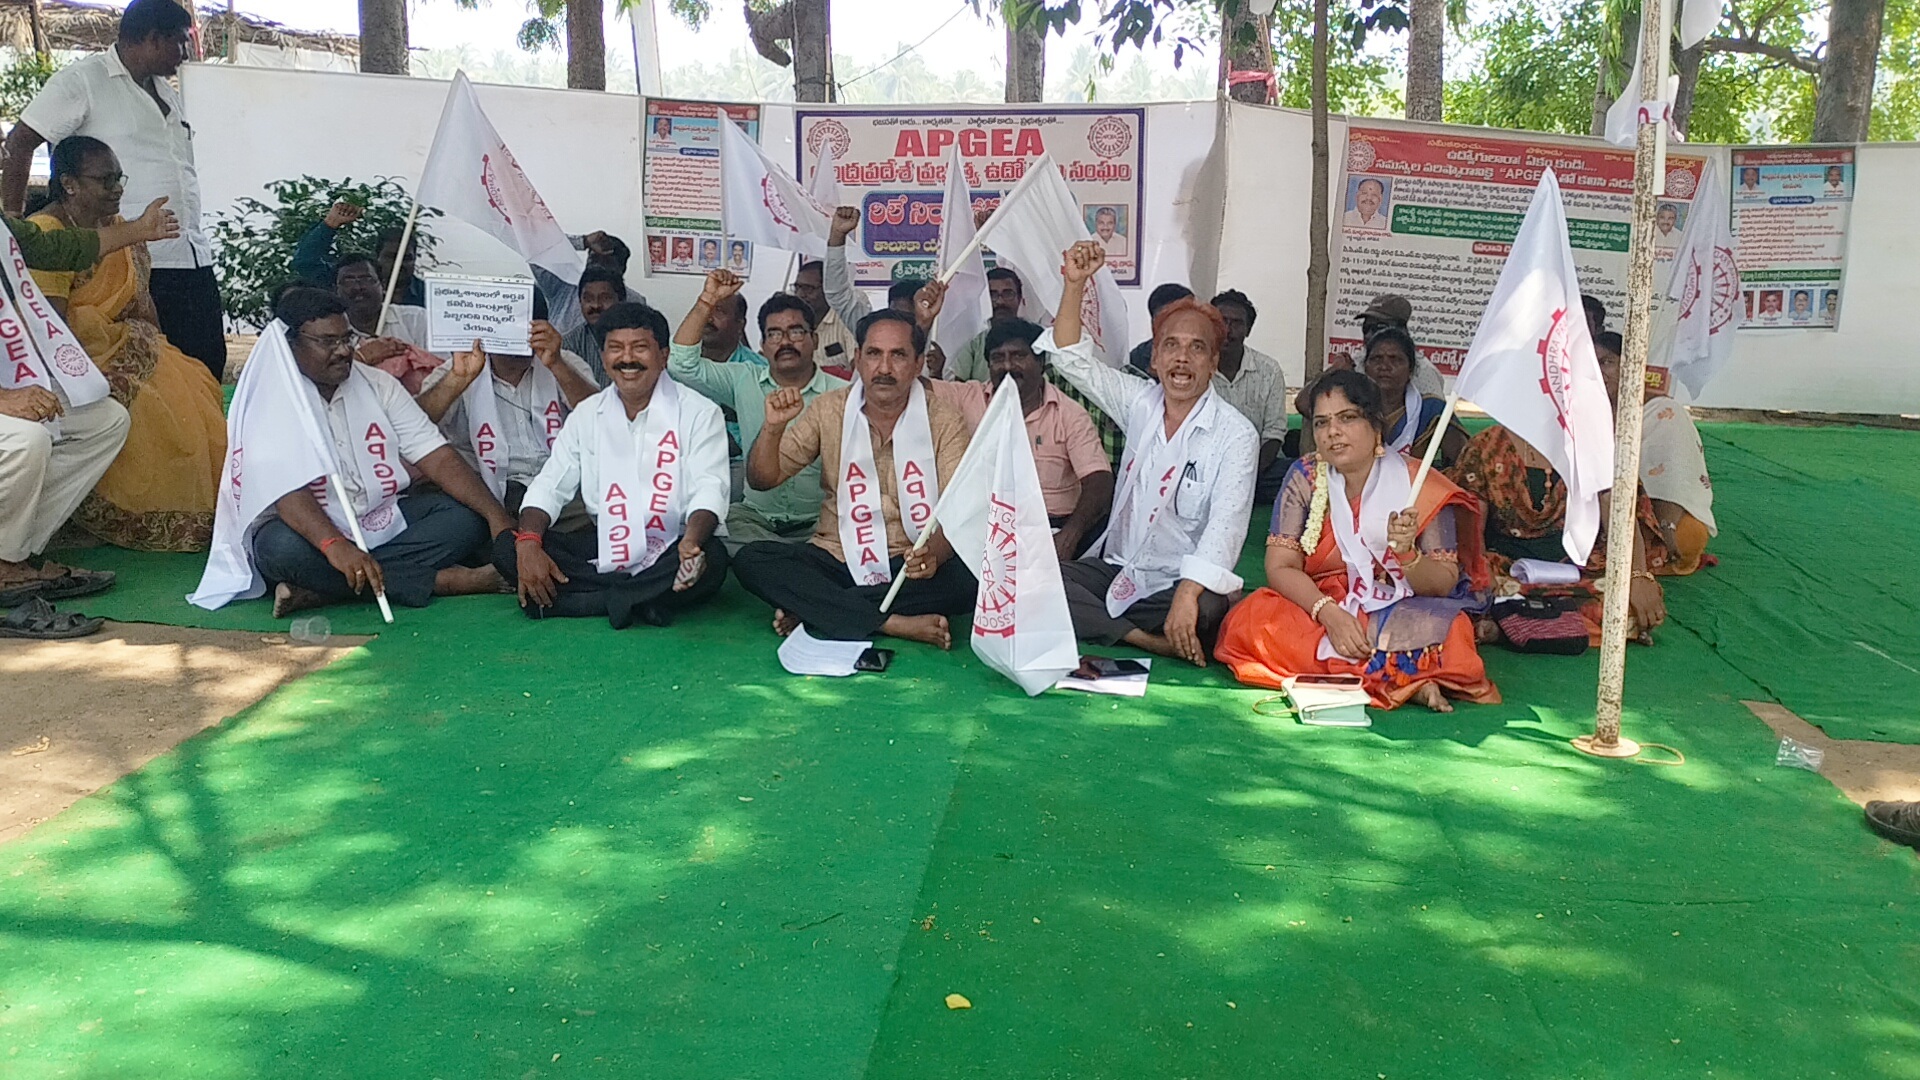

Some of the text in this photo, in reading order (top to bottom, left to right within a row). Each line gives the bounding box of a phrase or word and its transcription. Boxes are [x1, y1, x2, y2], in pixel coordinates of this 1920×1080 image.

[894, 128, 1045, 157] APGEA
[868, 195, 908, 225] రిలే
[8, 236, 64, 339] APGEA
[645, 430, 679, 532] APGEA
[845, 462, 879, 566] APGEA
